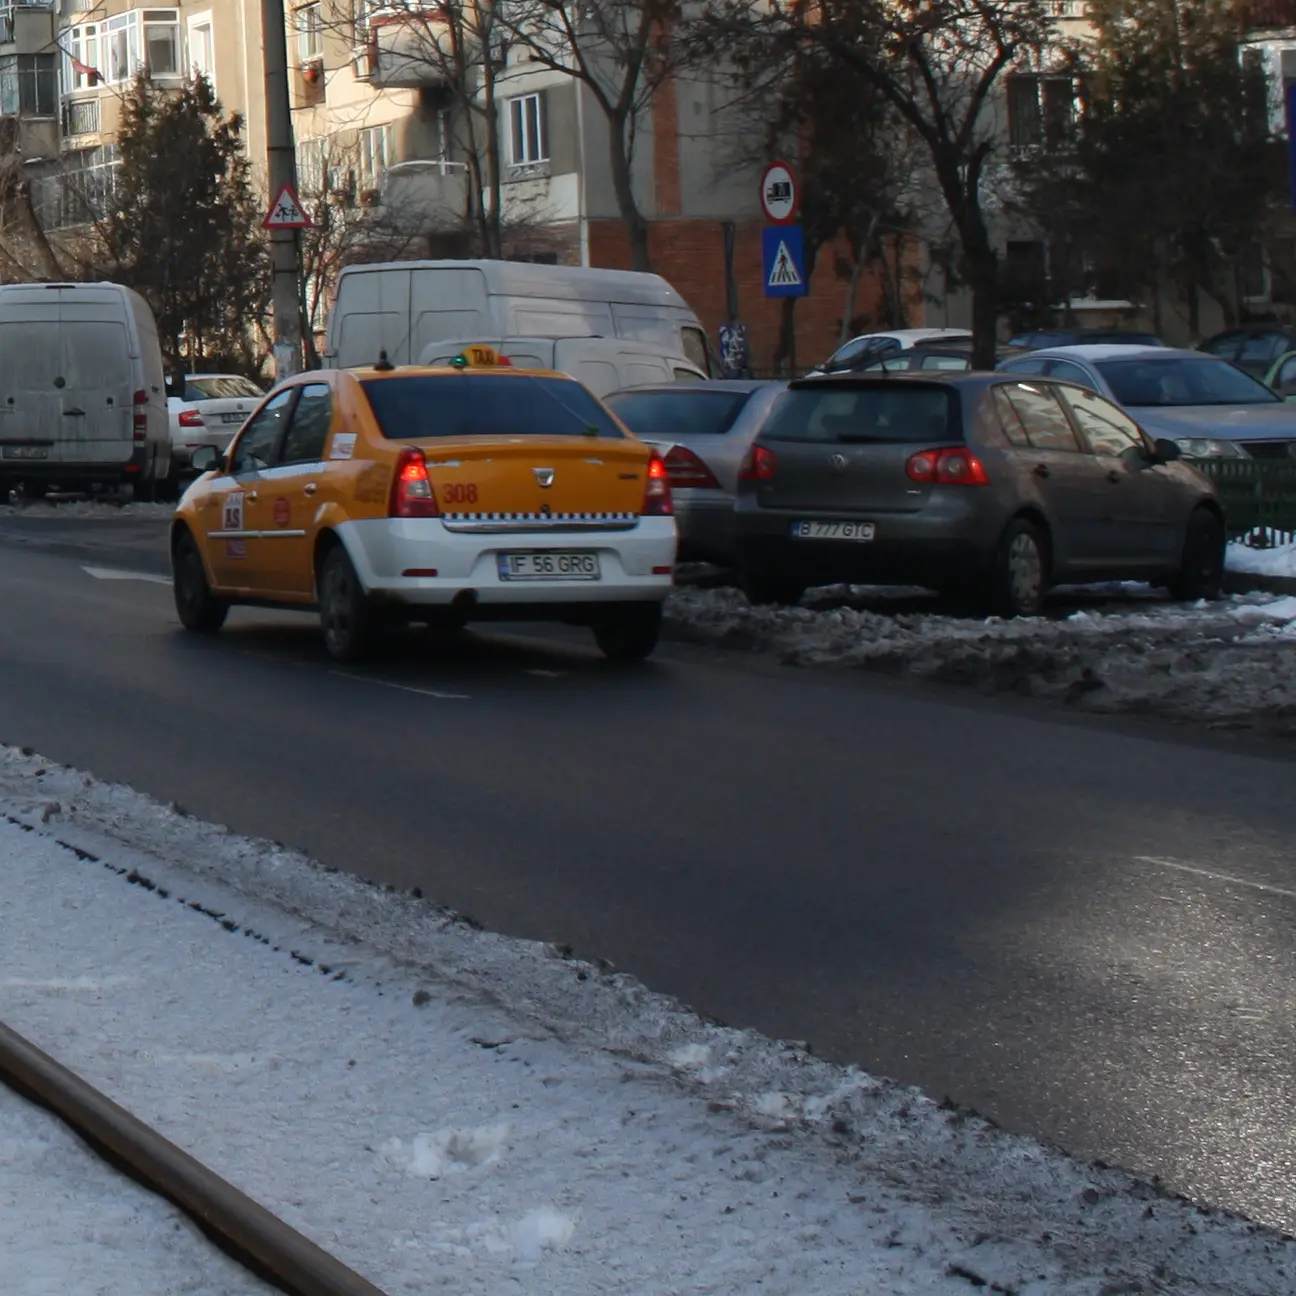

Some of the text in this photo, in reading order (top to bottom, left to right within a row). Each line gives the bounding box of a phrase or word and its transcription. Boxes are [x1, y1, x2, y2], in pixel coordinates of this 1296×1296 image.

[443, 483, 478, 504] 308
[800, 521, 872, 538] B 777 GTC
[510, 556, 595, 574] IF 56 GRG
